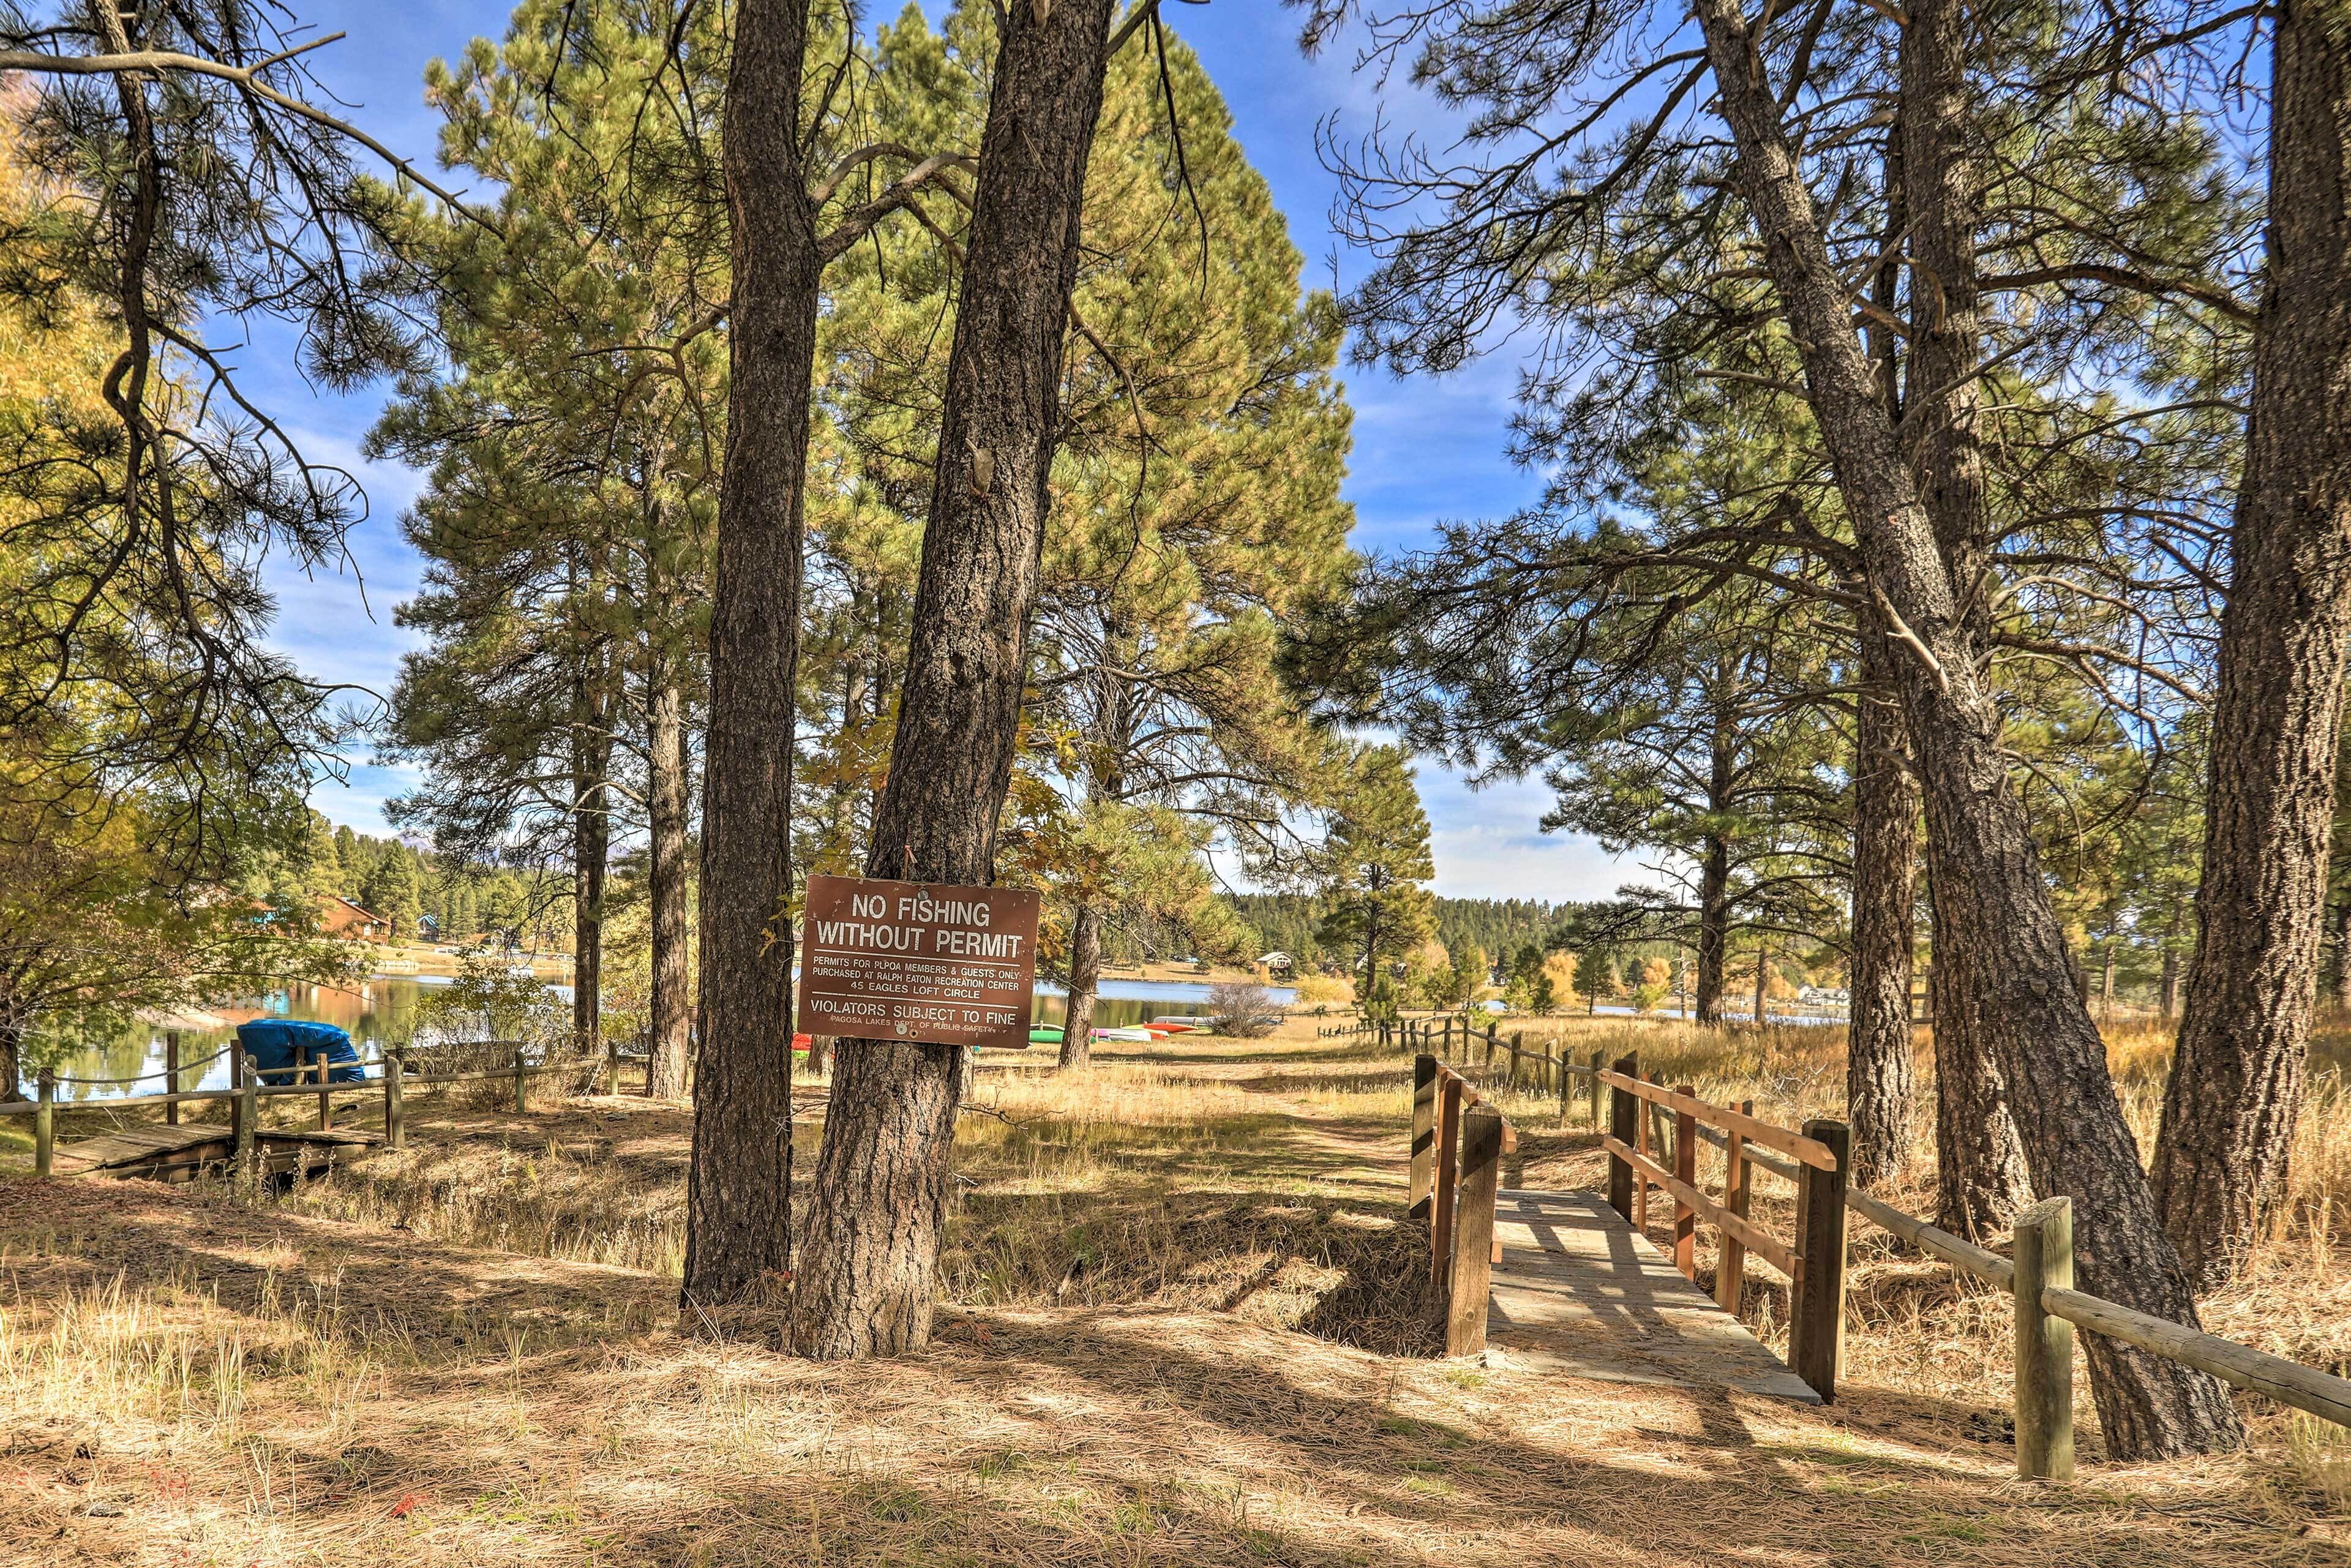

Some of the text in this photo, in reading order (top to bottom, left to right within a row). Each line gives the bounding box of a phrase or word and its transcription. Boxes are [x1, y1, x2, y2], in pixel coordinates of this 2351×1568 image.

[852, 893, 990, 927] NO FISHING
[817, 920, 1023, 958] WITHOUT PERMIT
[812, 967, 1019, 991] PURCHASED AT RALPH EATON RECREATION CENTER
[813, 956, 1020, 980] PERMITS FOR PLPOA MEMBERS & GUESTS ONLY
[850, 981, 980, 999] 45 EAGLES LOFT CIRCLE
[811, 999, 1016, 1026] VIOLATORS SUBJECT TO FINE
[831, 1015, 863, 1024] PAGOSA
